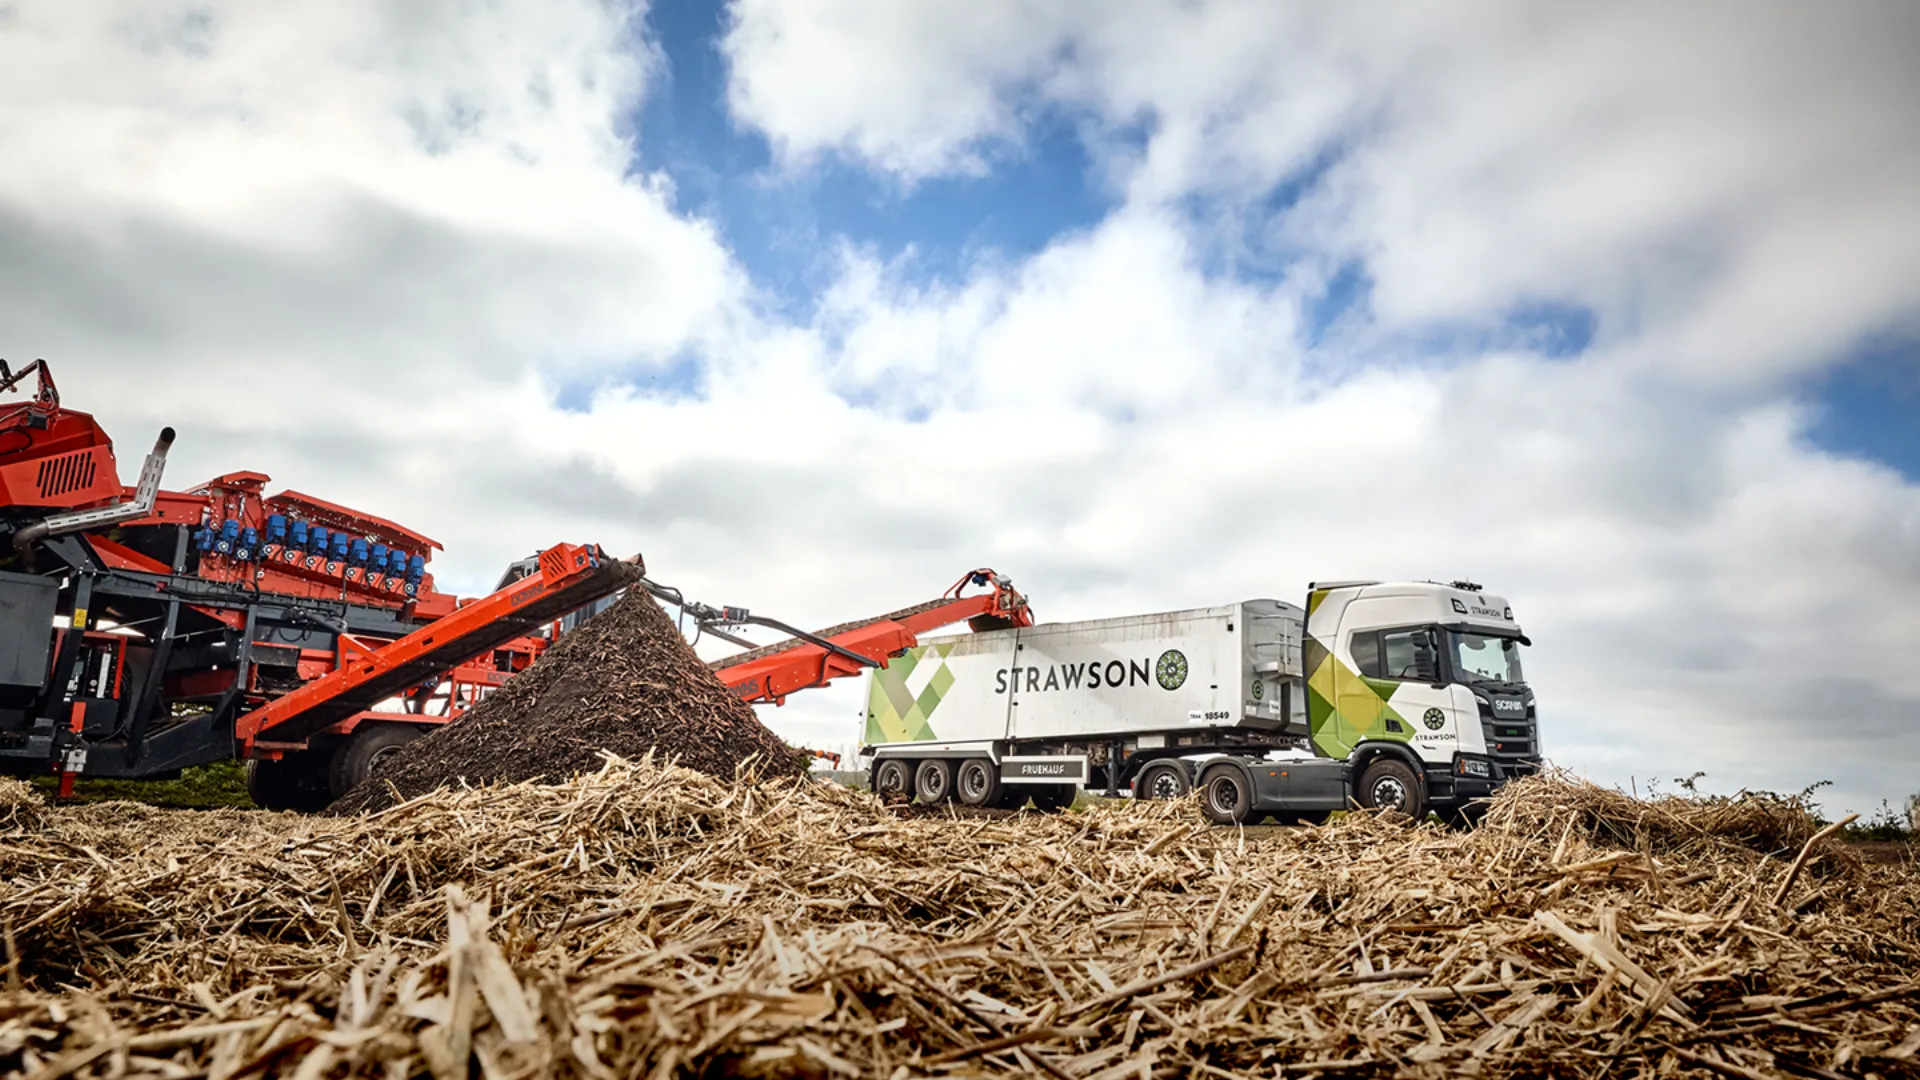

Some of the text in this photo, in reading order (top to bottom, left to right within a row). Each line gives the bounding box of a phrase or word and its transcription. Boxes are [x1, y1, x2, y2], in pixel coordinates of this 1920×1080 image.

[1471, 606, 1501, 617] STRAWSON
[995, 658, 1150, 694] STRAWSON
[1495, 699, 1524, 711] SCANIA
[1415, 733, 1456, 742] STRAWSON
[1022, 764, 1065, 775] FRUEHAUF
